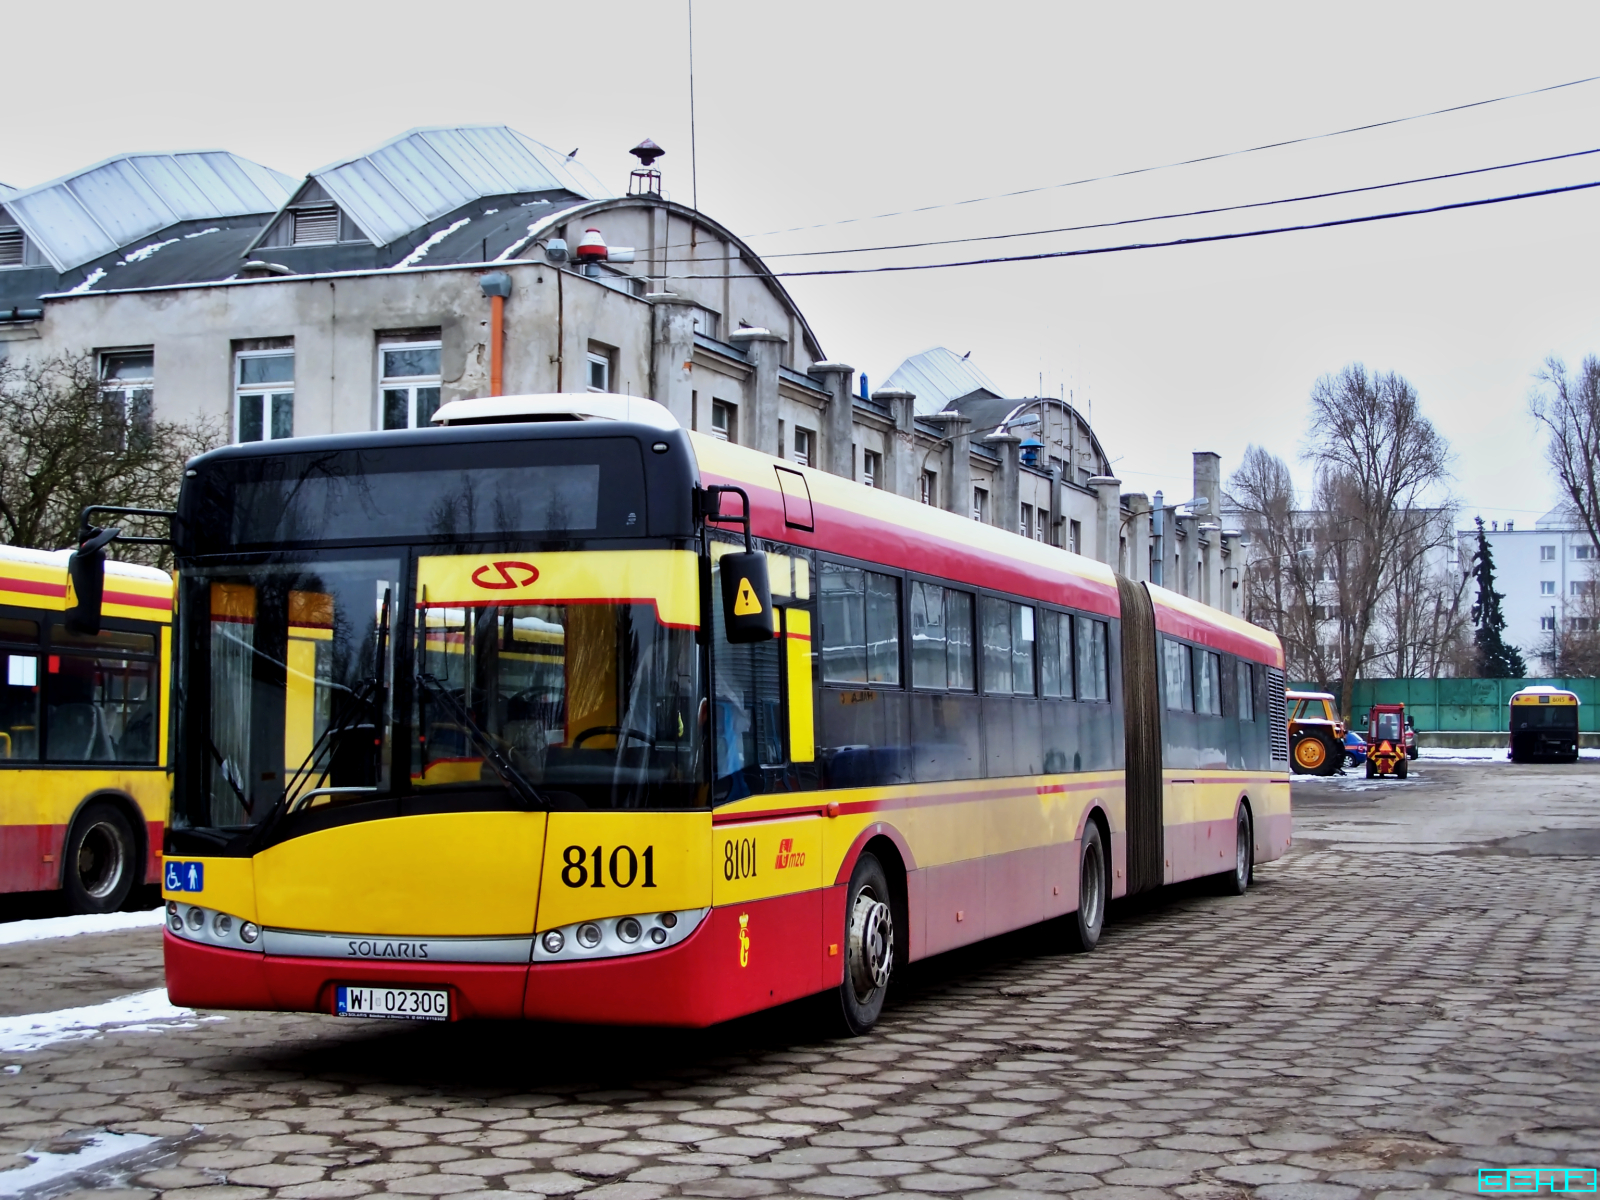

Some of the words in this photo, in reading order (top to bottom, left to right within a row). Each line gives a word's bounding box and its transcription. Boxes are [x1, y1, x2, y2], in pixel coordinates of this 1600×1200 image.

[562, 844, 657, 888] 8101
[724, 837, 757, 881] 8101
[348, 940, 428, 958] SOLARIS
[350, 989, 373, 1010] WI
[385, 991, 446, 1014] 0230G
